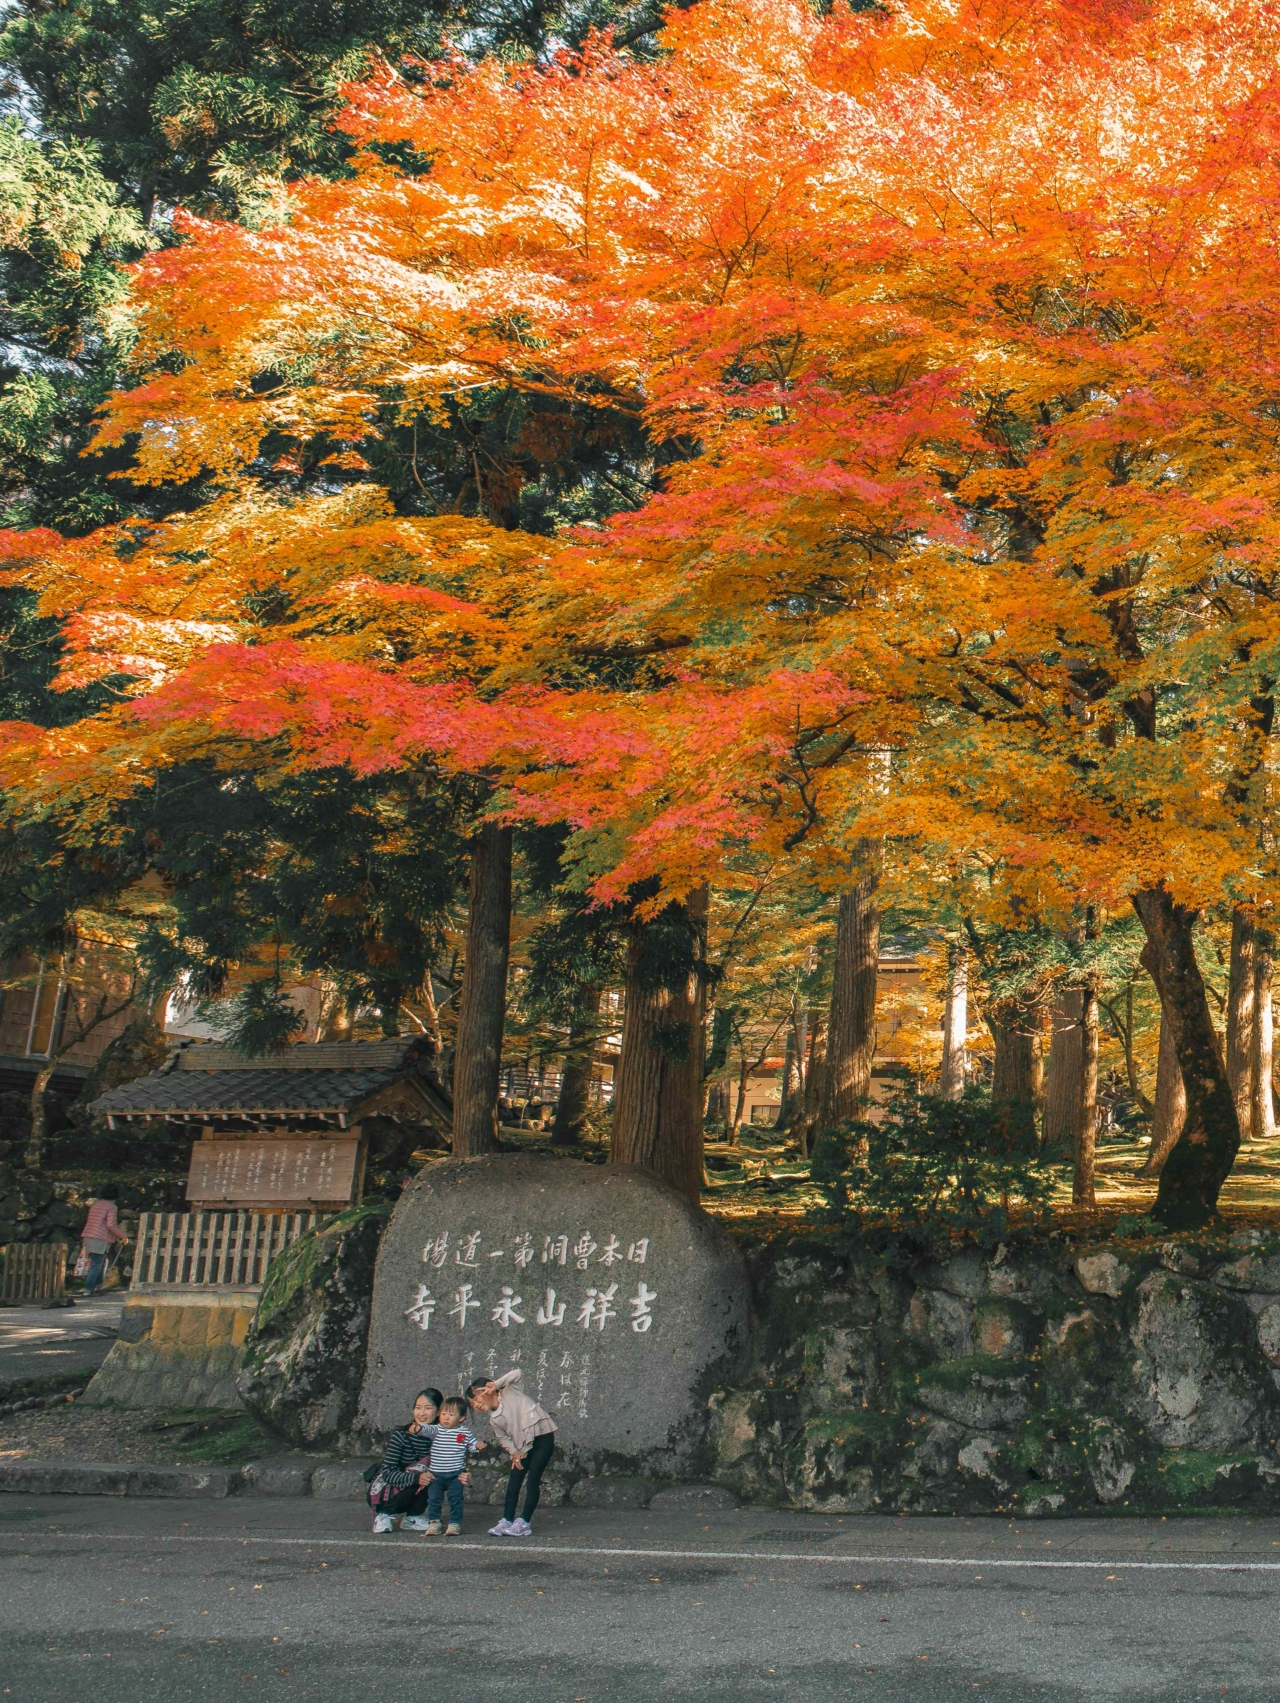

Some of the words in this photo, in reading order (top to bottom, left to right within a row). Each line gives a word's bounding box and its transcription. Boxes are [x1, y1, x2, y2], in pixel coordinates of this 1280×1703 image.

[404, 1281, 658, 1333] 吉祥山永平寺
[536, 1348, 549, 1406] 夏ほとと
[556, 1351, 574, 1409] 春は花
